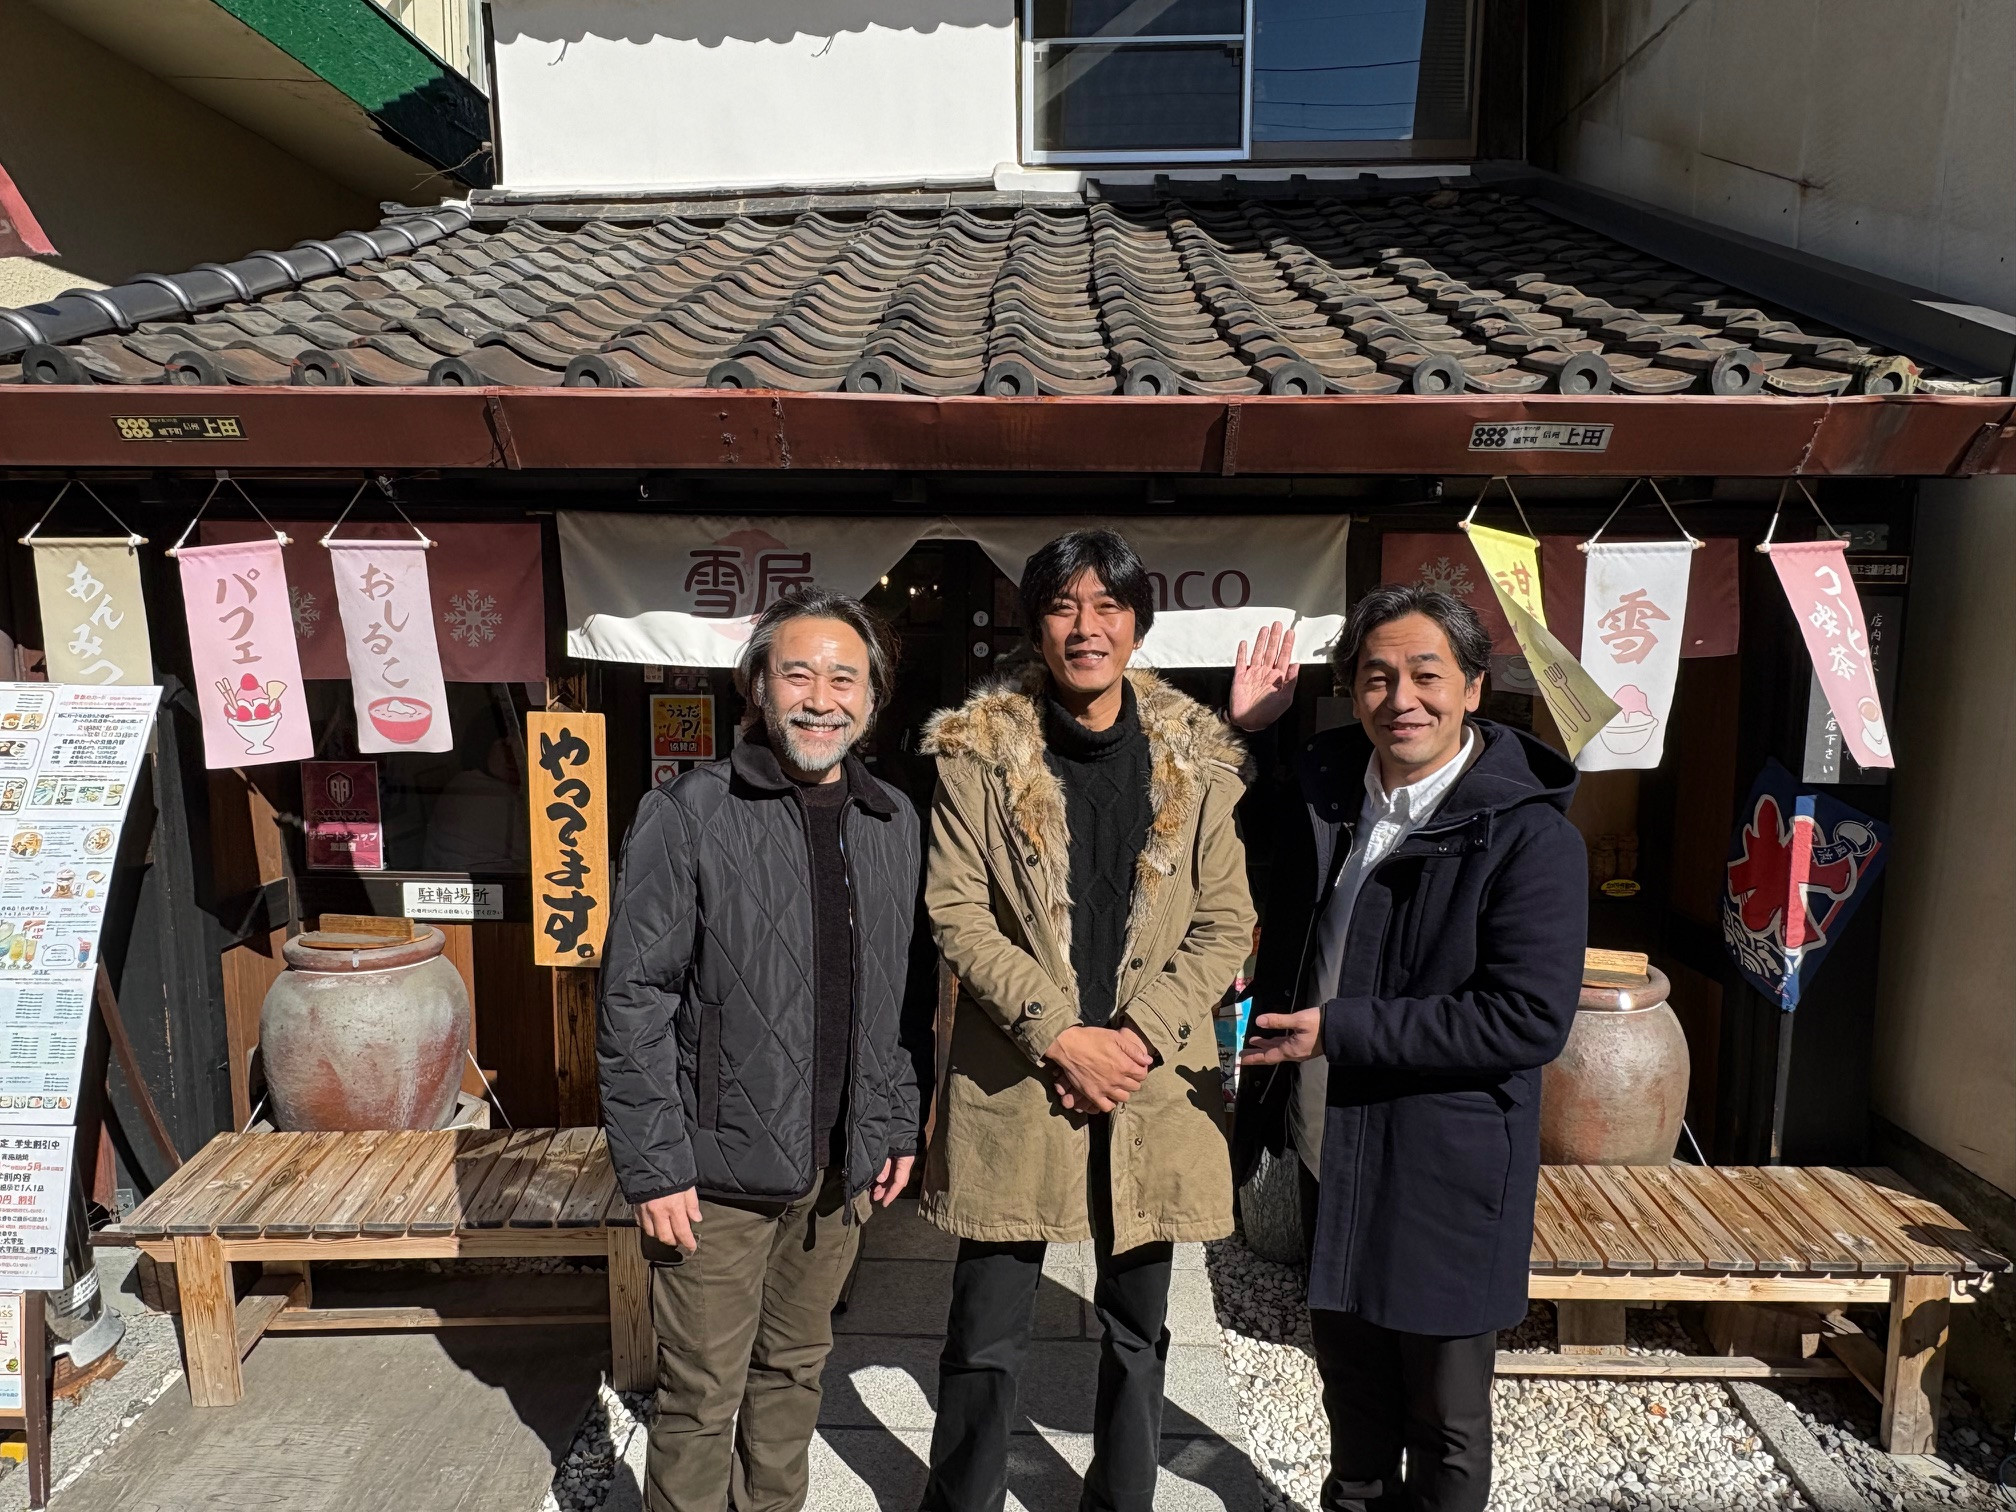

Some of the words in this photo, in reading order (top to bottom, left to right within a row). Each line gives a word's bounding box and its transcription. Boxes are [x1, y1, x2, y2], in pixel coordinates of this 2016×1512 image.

[203, 418, 240, 437] 上田
[1559, 428, 1605, 446] 上田
[65, 560, 124, 686] あんみつ
[216, 568, 262, 665] パフェ
[684, 550, 814, 624] 雪屋
[359, 563, 410, 689] おしるこ
[1597, 588, 1671, 665] 雪
[1808, 600, 1858, 680] 喫茶
[1815, 565, 1875, 693] コーヒー
[665, 720, 700, 739] UP!
[666, 704, 701, 718] うえだ
[539, 728, 597, 958] やってます。
[418, 887, 490, 904] 駐輪場所
[15, 1139, 60, 1149] 学生割引中
